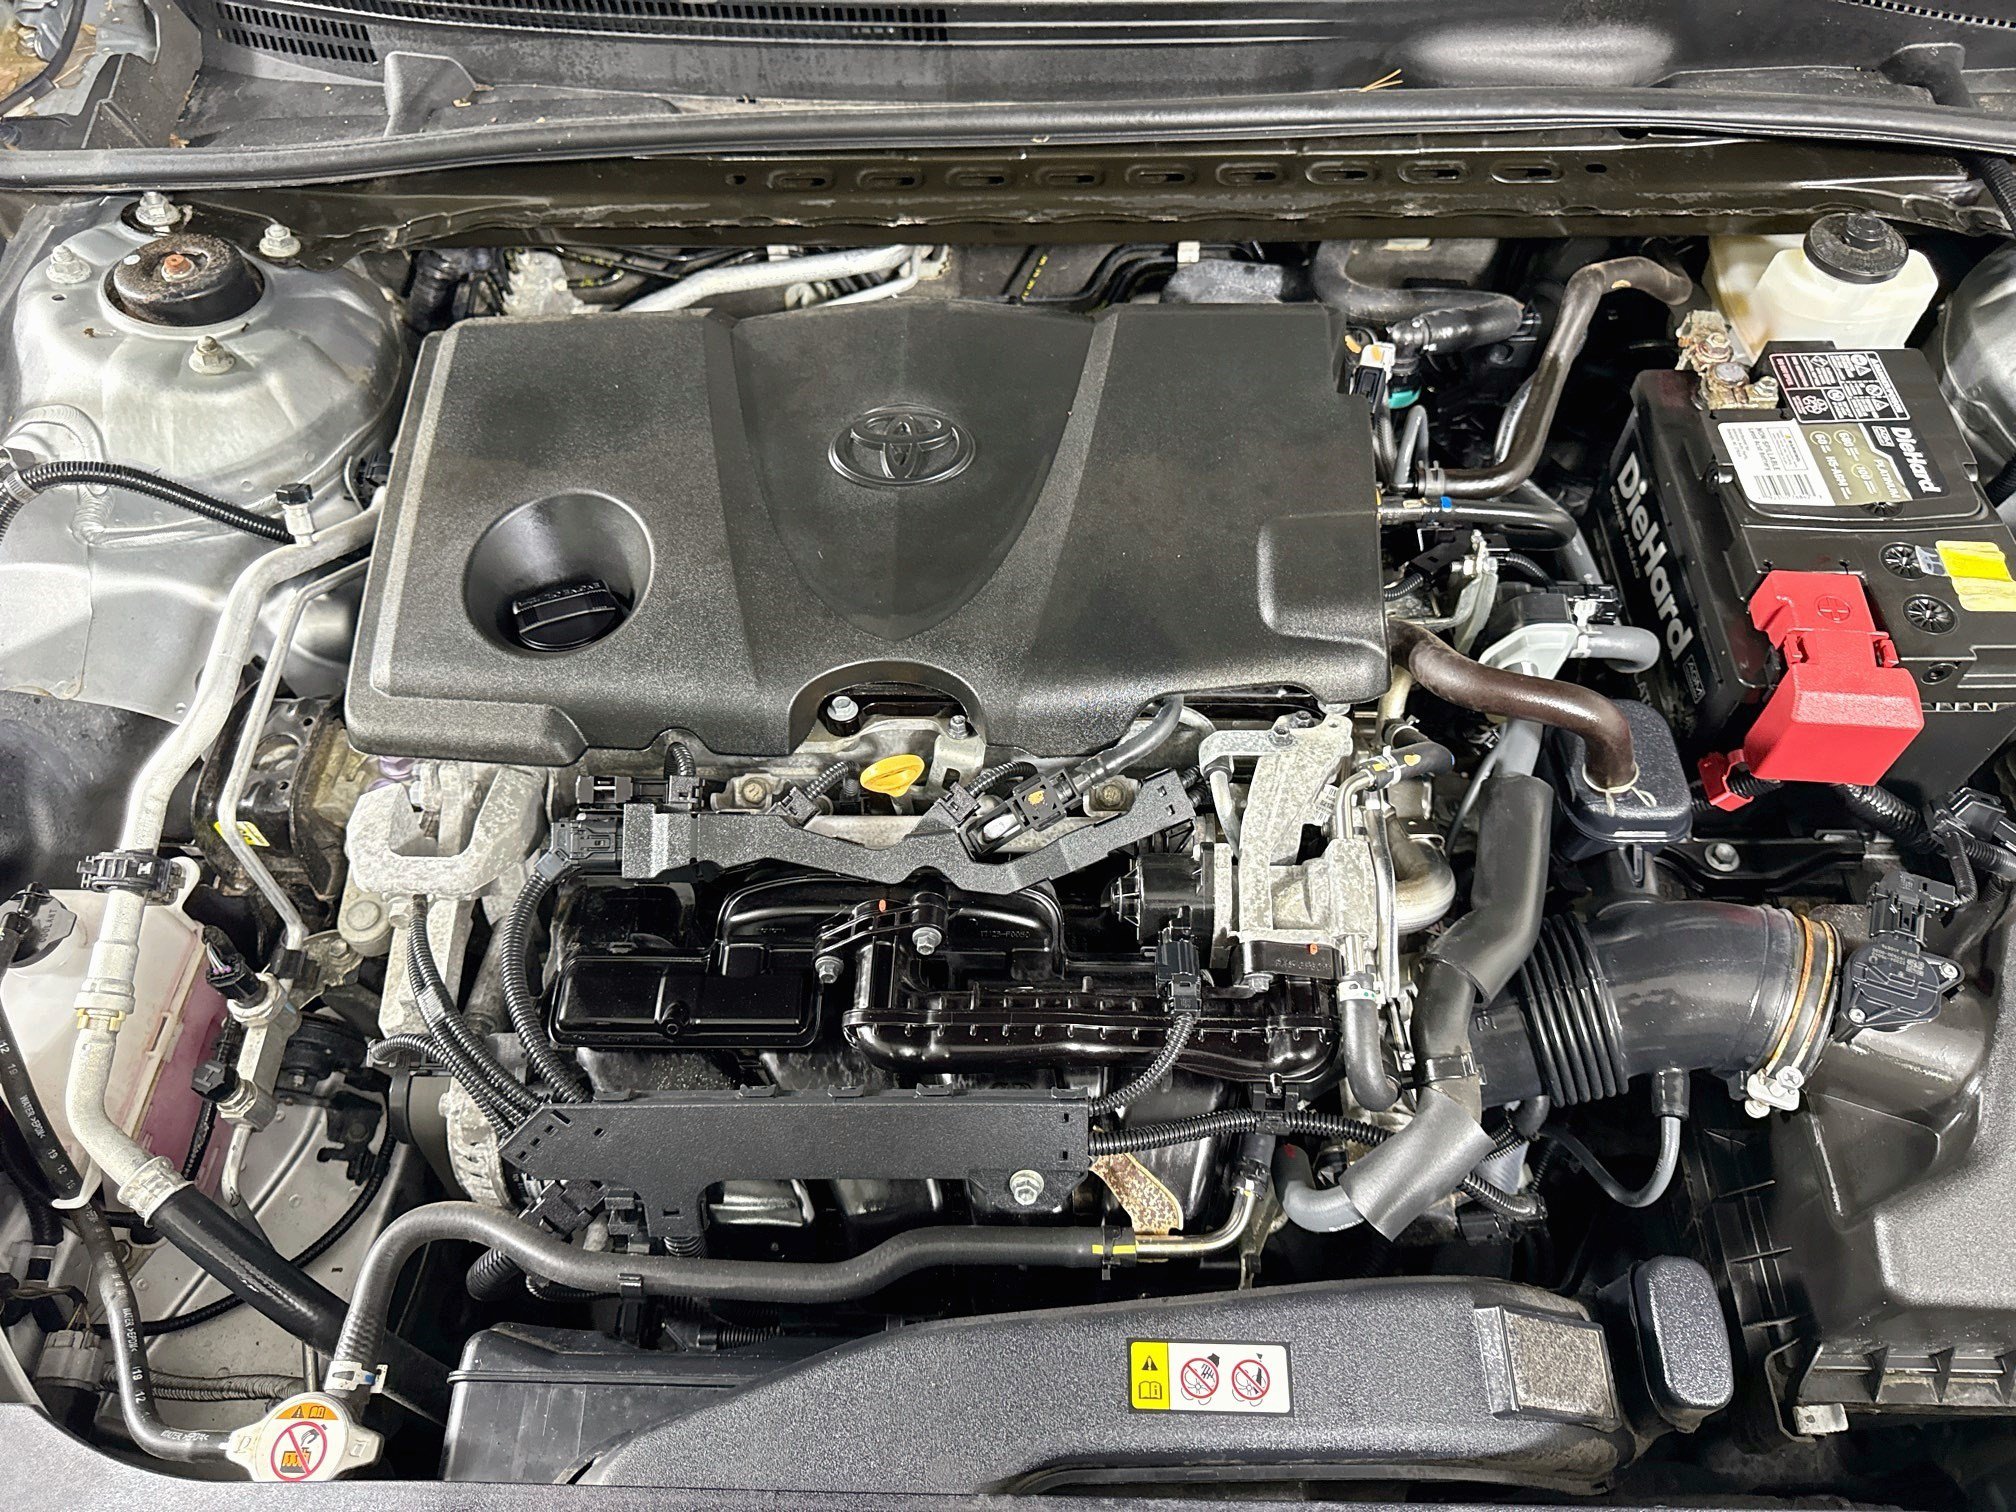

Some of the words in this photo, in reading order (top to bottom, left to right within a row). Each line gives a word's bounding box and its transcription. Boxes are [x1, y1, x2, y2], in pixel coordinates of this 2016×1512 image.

[1874, 459, 1901, 499] PLATINUM
[1891, 427, 1941, 493] DieHard
[1610, 485, 1626, 531] POWER
[1623, 534, 1640, 579] AHEAD
[1617, 451, 1694, 661] DieHard
[19, 1094, 36, 1118] WATER
[122, 1307, 134, 1331] WATER
